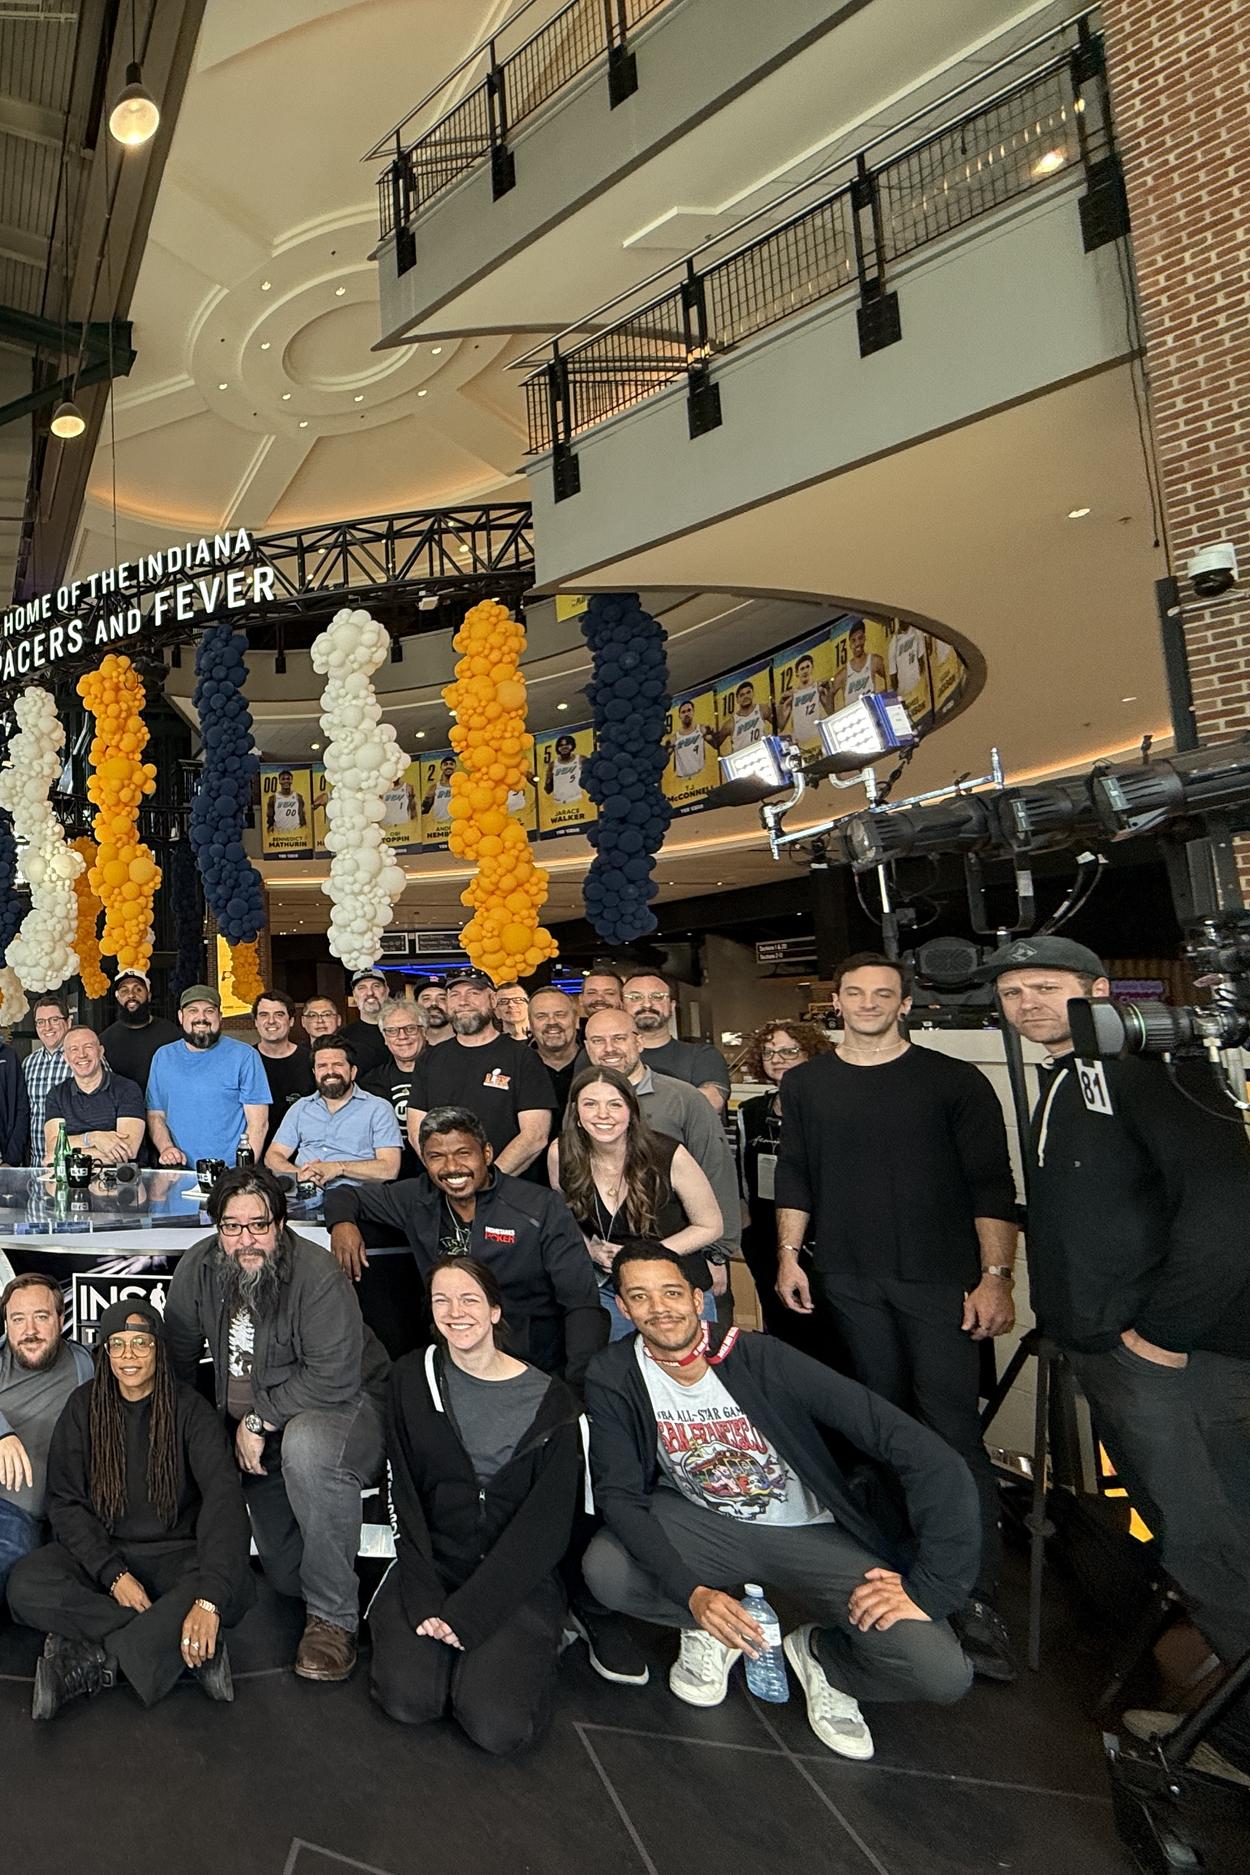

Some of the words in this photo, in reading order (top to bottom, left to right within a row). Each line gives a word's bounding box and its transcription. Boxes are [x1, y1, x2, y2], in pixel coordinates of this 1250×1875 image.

[3, 593, 52, 638] HOME
[56, 581, 81, 613] OF
[87, 561, 130, 598] THE
[138, 527, 251, 582] INDIANA
[95, 608, 142, 645] AND
[154, 566, 275, 627] FEVER
[835, 638, 847, 667] 13
[780, 667, 793, 692] 12
[722, 692, 735, 716] 10
[750, 729, 760, 742] 10
[544, 745, 552, 764] 5
[427, 764, 436, 781] 2
[264, 776, 278, 793] 00
[285, 809, 296, 817] 00
[550, 813, 585, 824] WALKER
[555, 808, 580, 816] JARACE
[1081, 1070, 1106, 1107] 81
[485, 1232, 516, 1244] POKER
[723, 1406, 746, 1418] GAM
[657, 1421, 691, 1454] SAN
[688, 1417, 769, 1455] FRANCISCO
